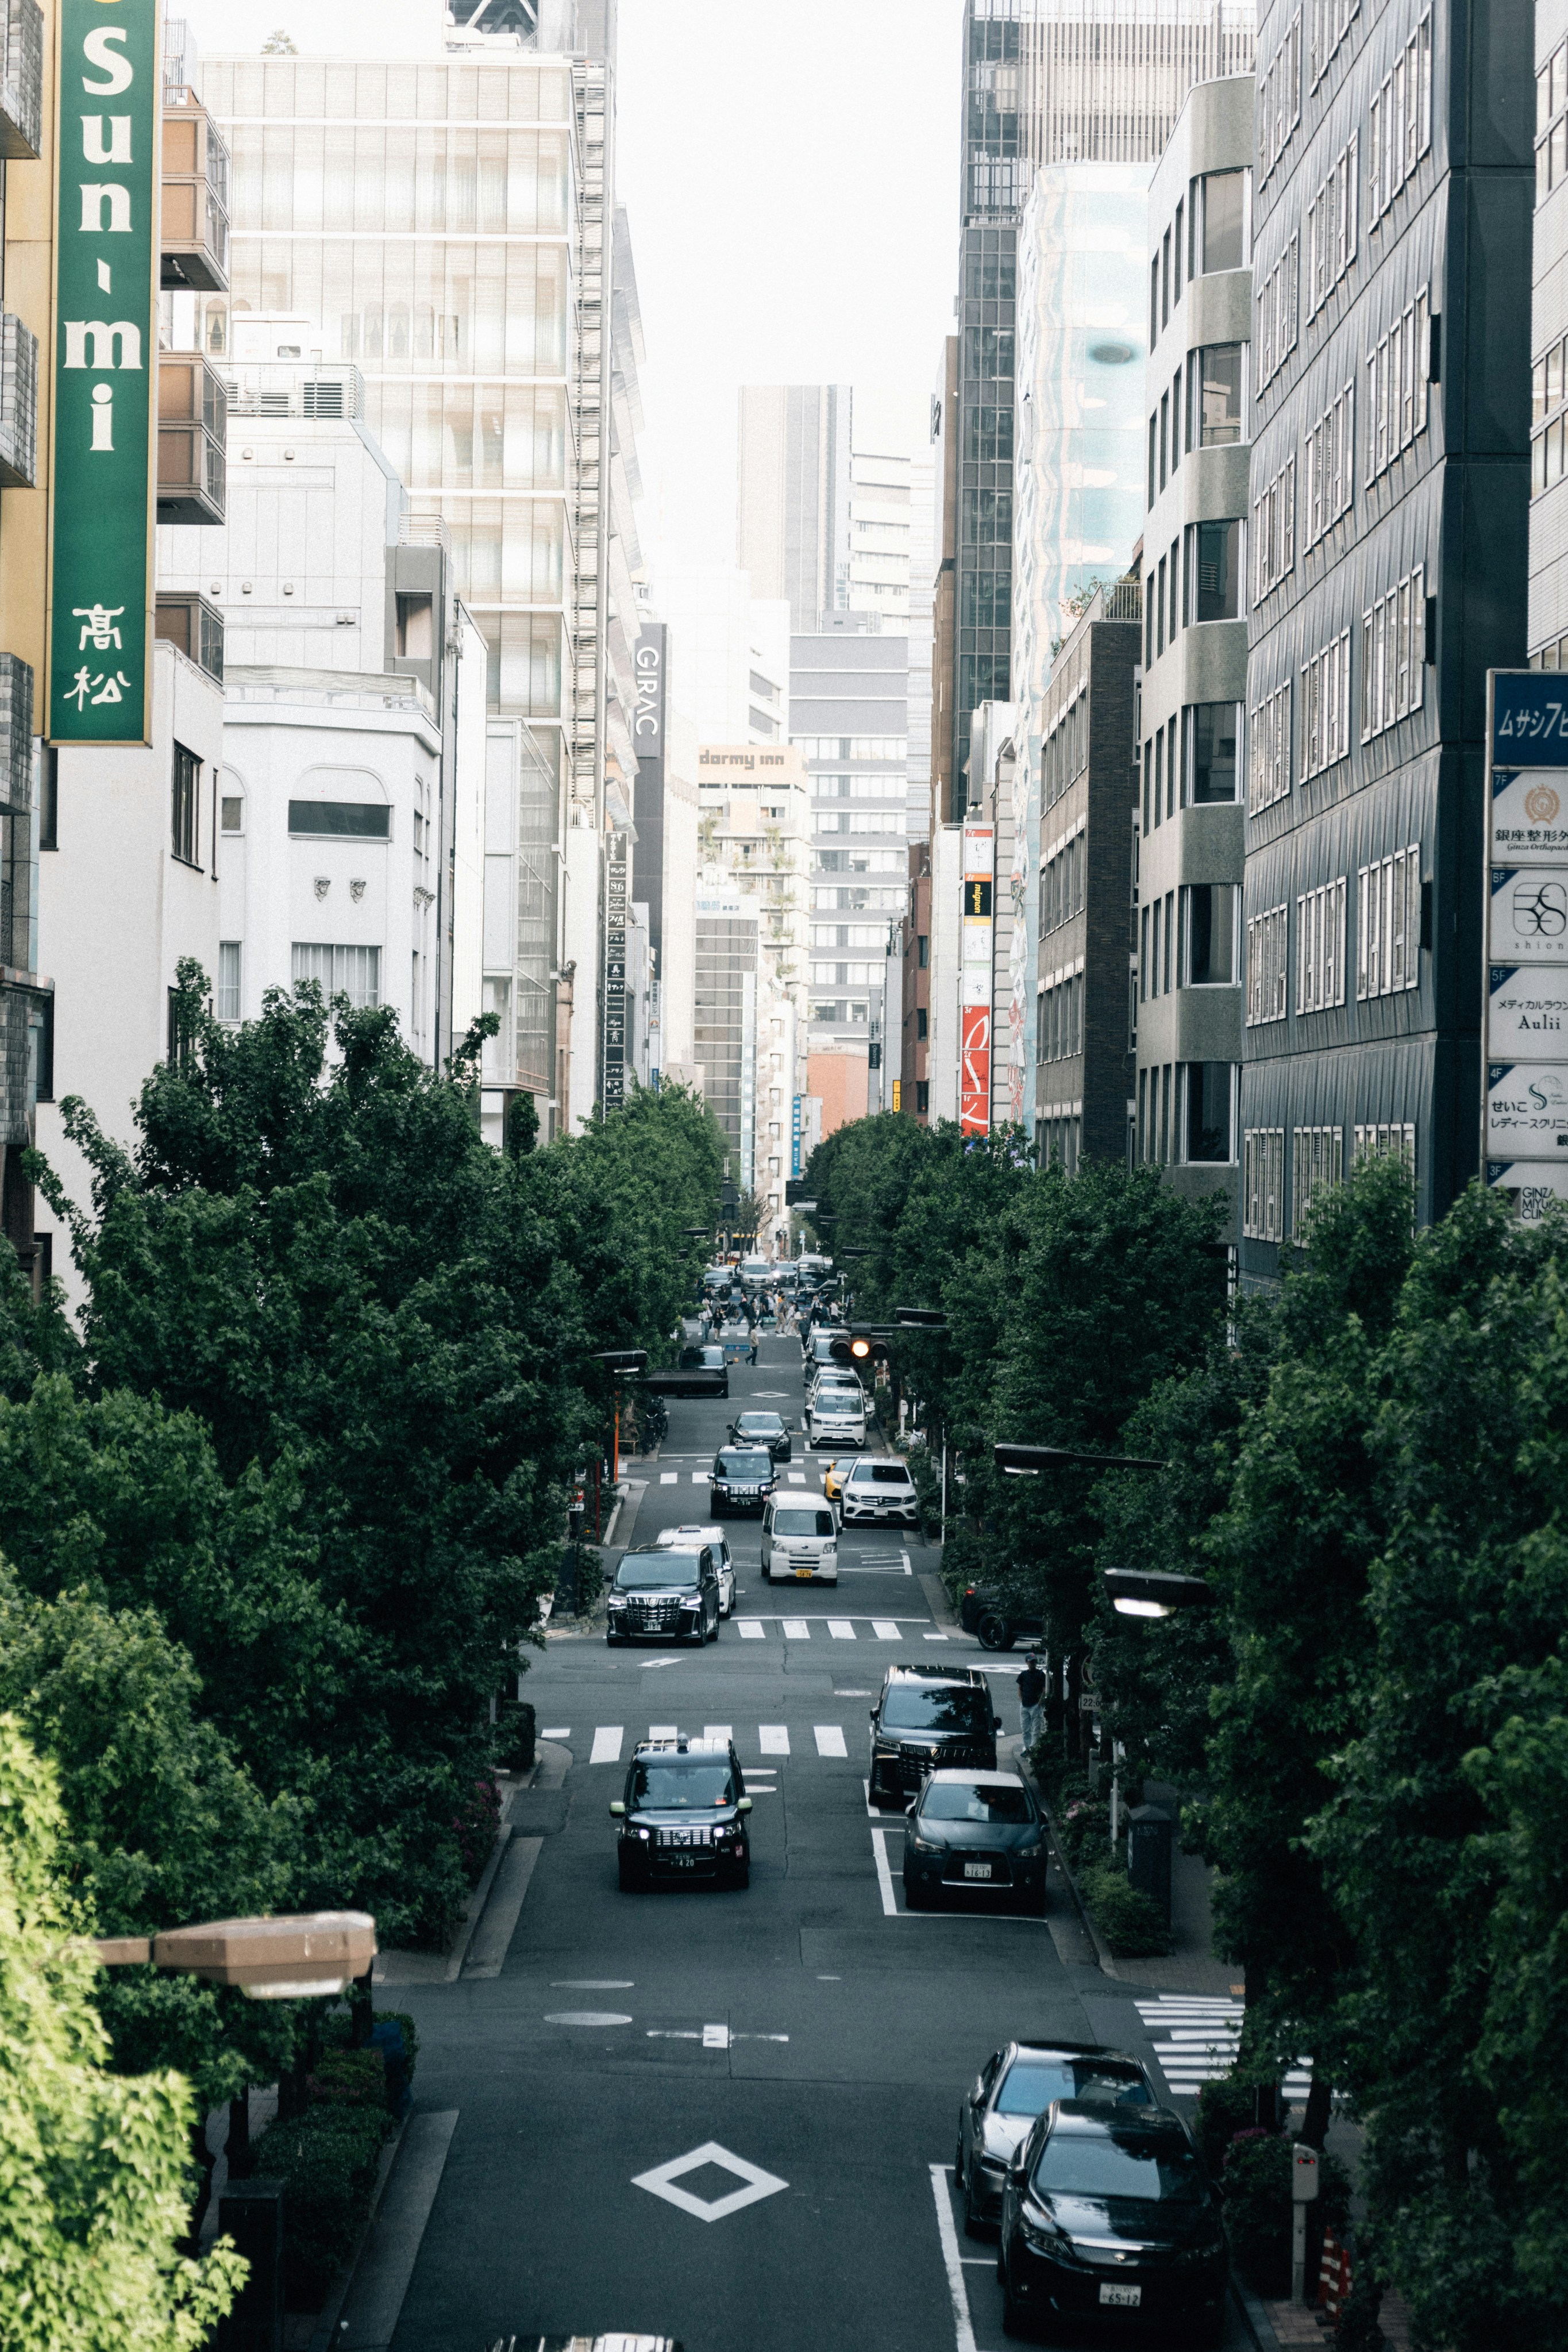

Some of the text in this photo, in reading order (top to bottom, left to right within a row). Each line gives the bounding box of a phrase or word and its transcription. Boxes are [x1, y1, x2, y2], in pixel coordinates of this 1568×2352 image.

[63, 603, 131, 712] 高松
[699, 750, 785, 769] dormy inn
[1495, 775, 1507, 786] 7F
[1507, 842, 1529, 851] Ginza
[1492, 872, 1505, 883] 6F
[972, 883, 983, 914] mignon
[1515, 941, 1564, 949] shion
[1492, 970, 1506, 981] 5F
[1518, 1014, 1561, 1030] Aulii
[1490, 1068, 1503, 1079] 4F
[1492, 1101, 1528, 1113] せいこ
[1491, 1118, 1568, 1129] レディースクリニ
[1489, 1165, 1502, 1176] 3F
